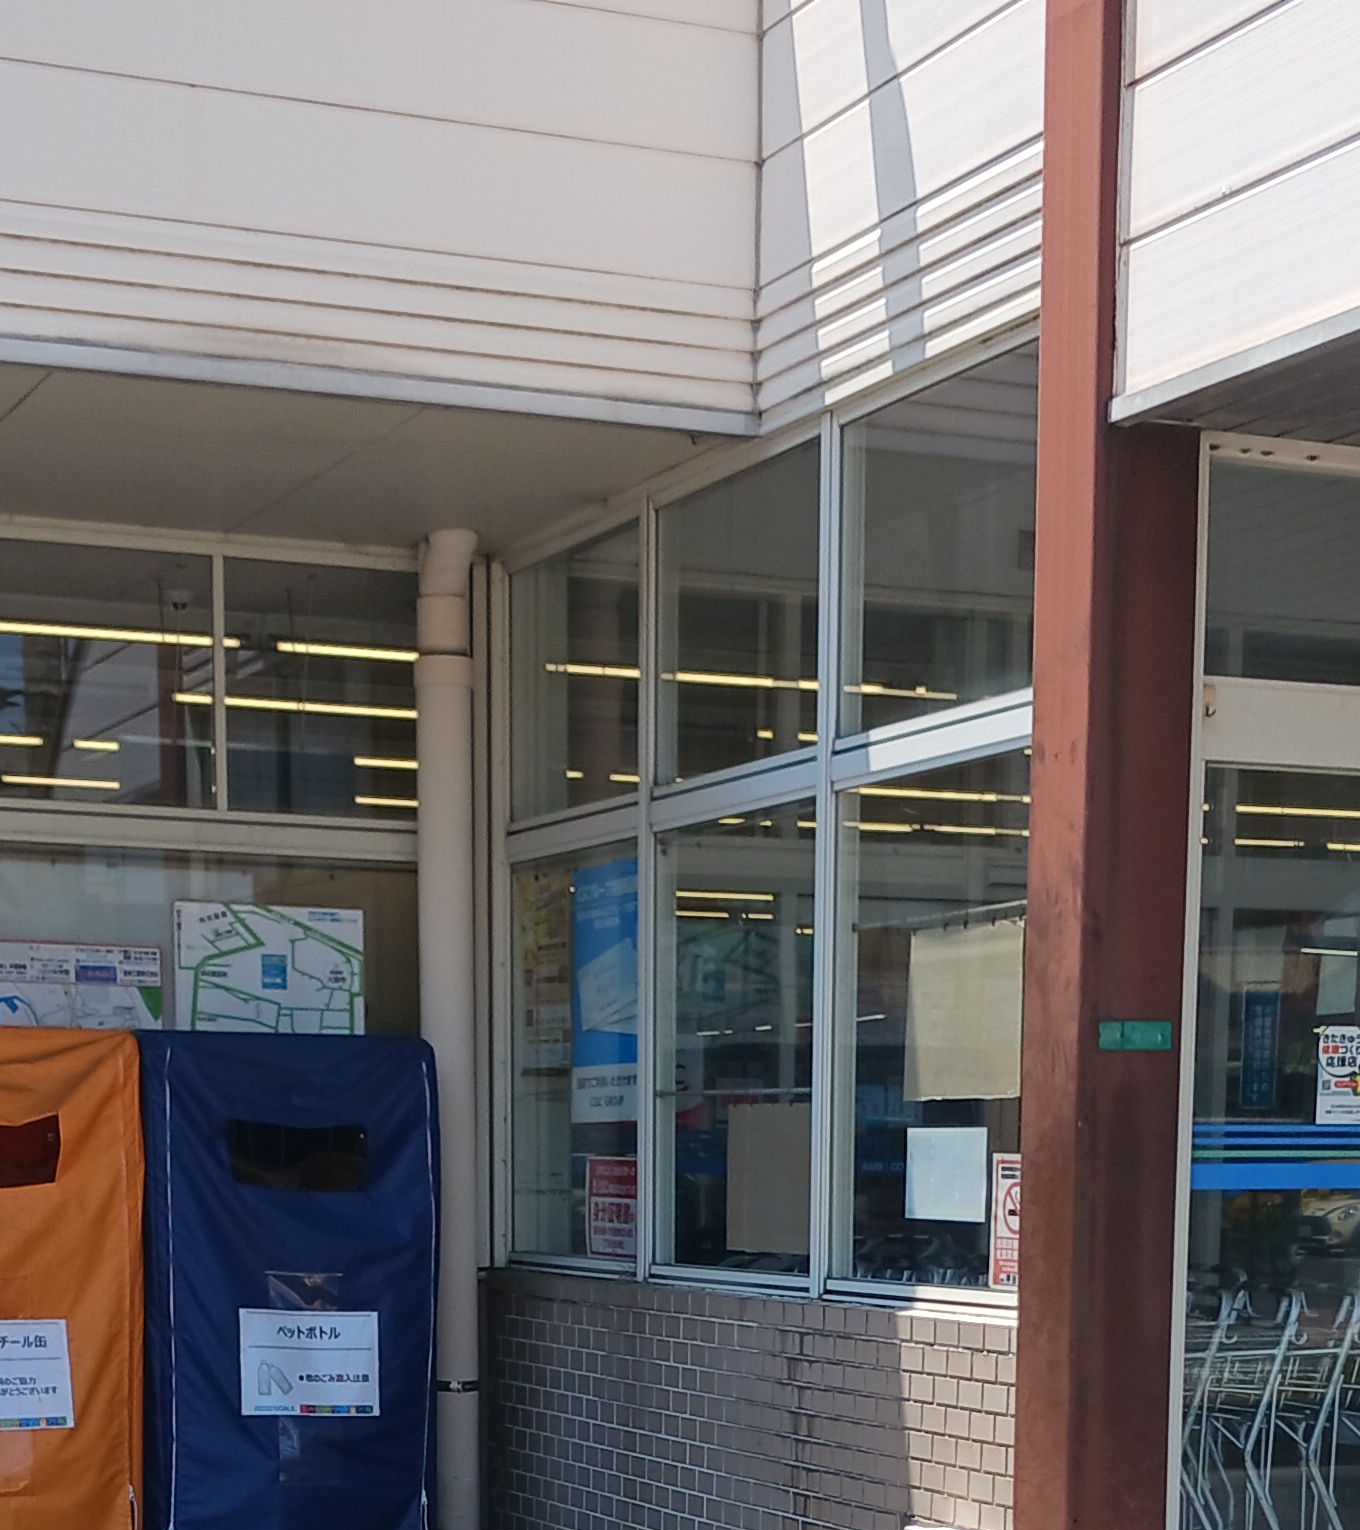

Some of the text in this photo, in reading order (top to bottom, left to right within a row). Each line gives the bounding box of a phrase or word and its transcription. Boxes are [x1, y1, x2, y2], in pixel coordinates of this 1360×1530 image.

[276, 1325, 341, 1340] ペットボトル
